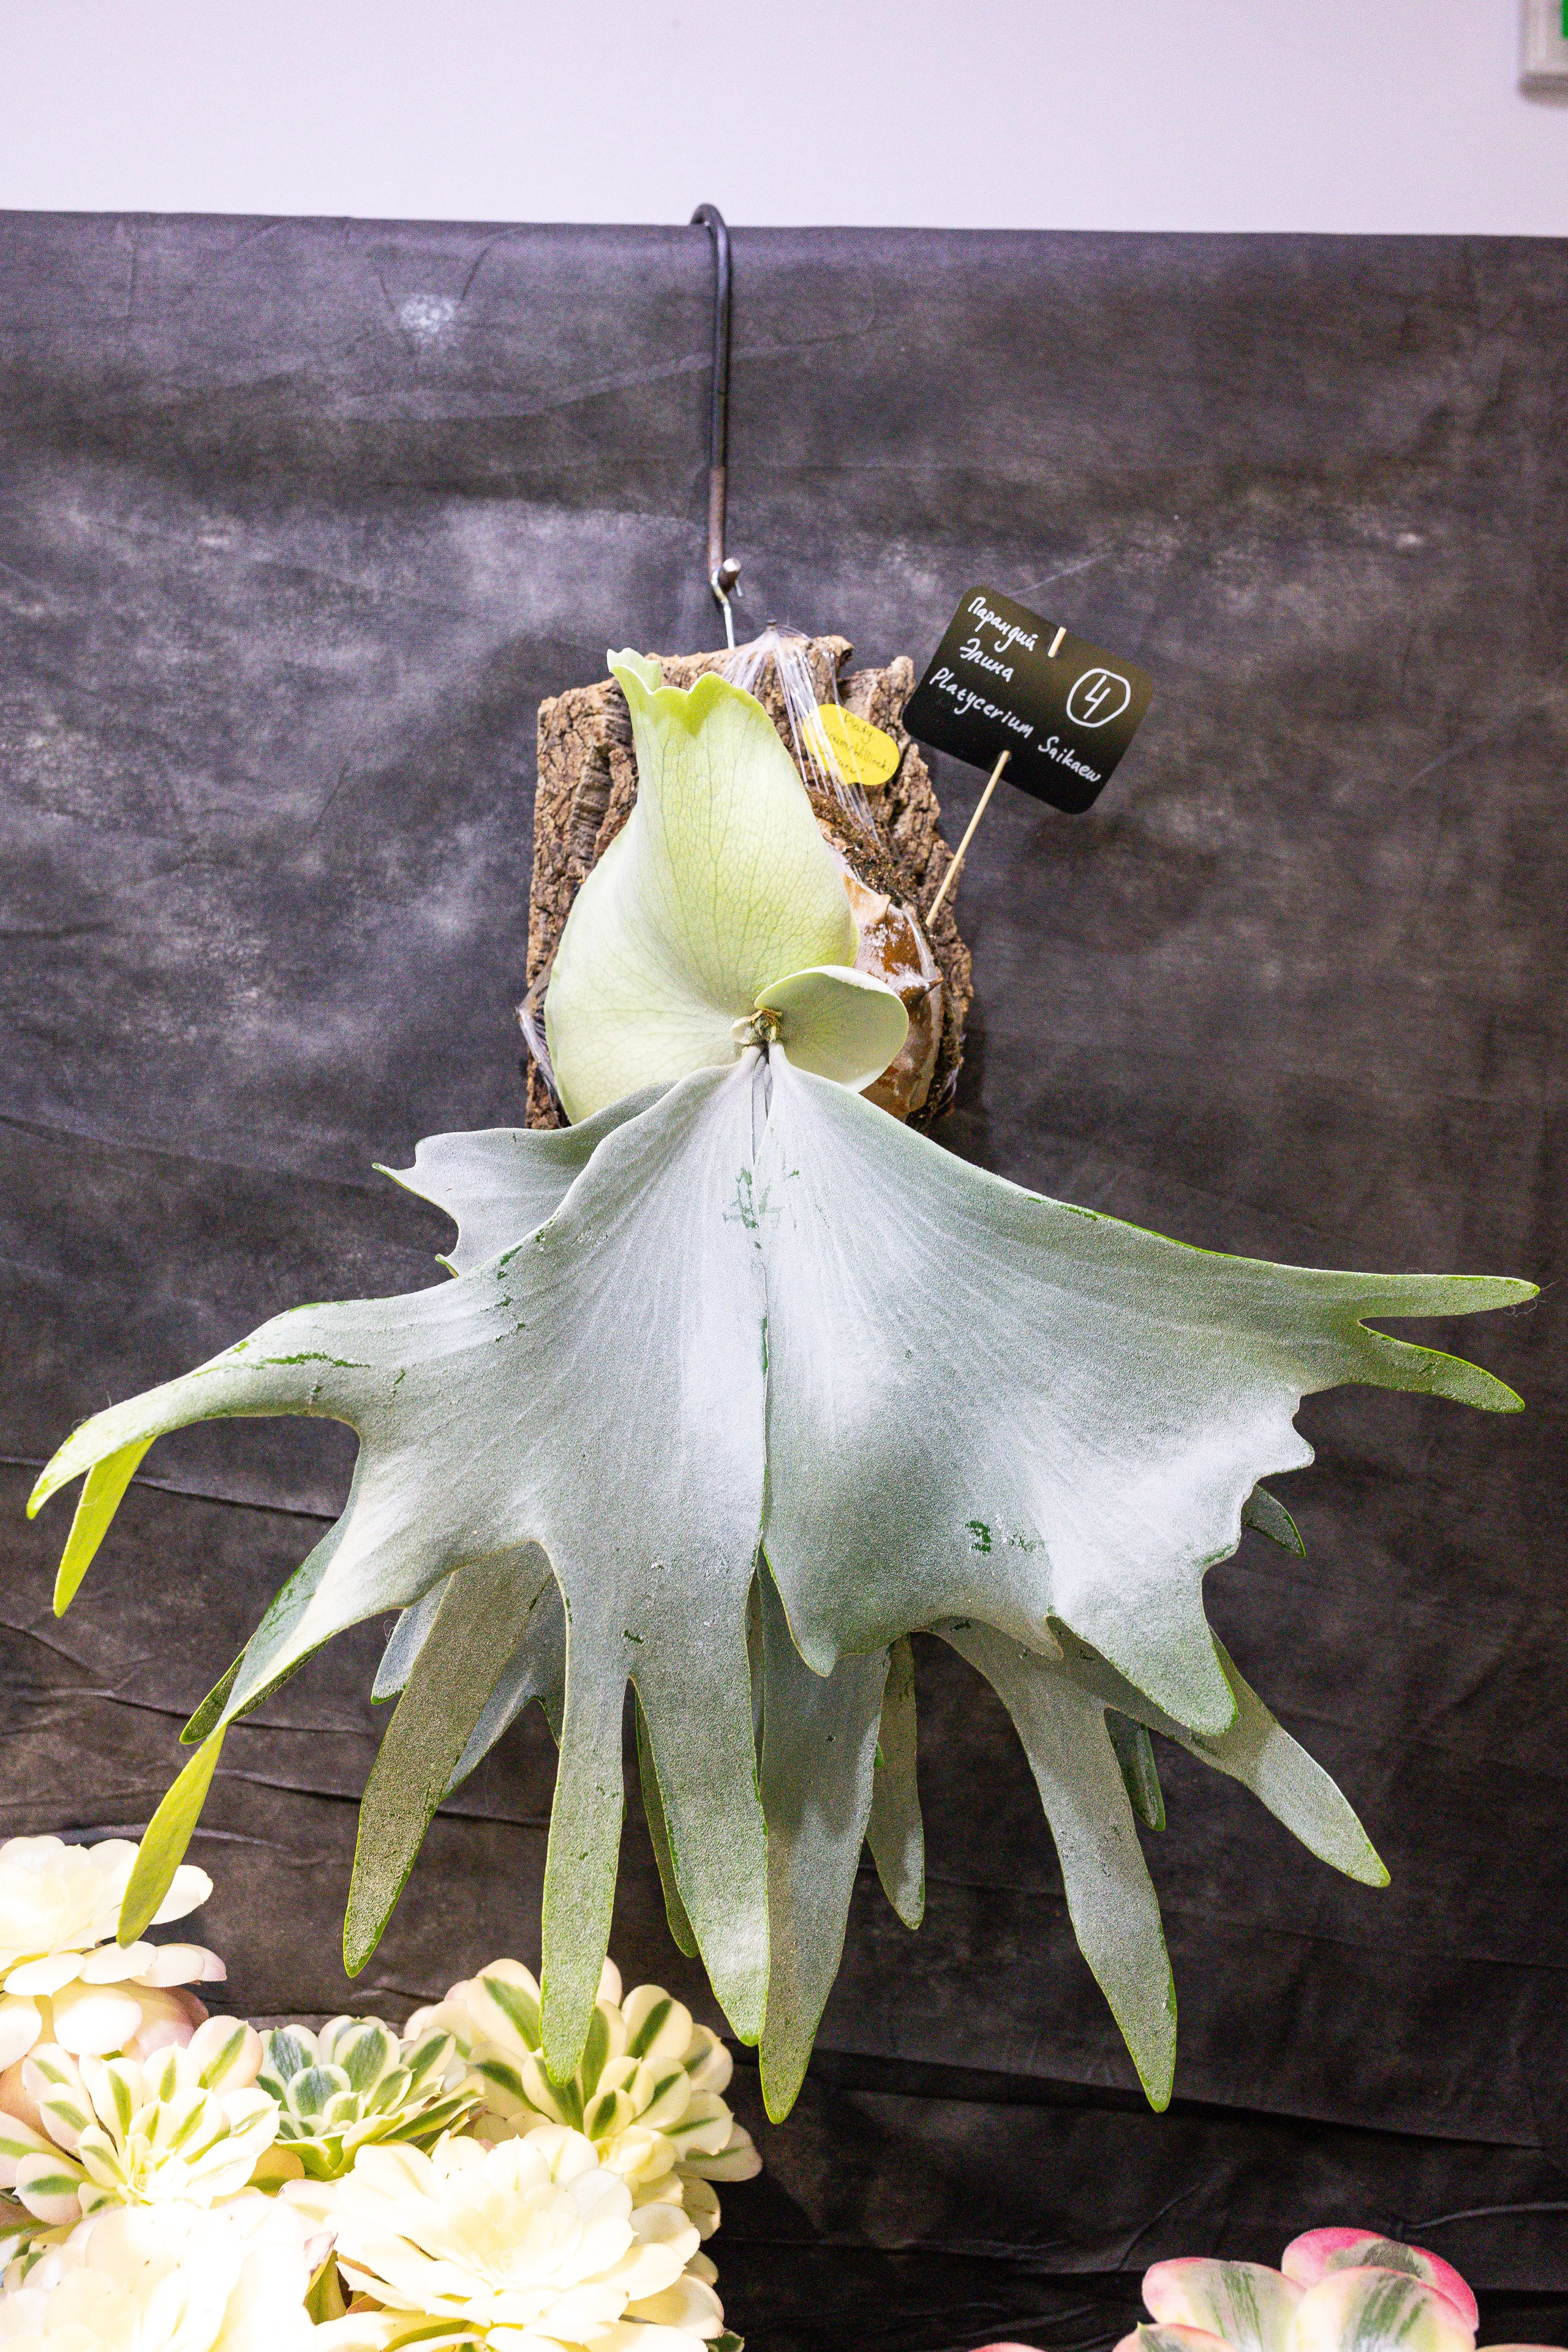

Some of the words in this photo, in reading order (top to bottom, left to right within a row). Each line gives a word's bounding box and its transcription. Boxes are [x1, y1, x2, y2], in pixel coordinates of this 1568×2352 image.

[959, 638, 1014, 682] Элина
[1084, 674, 1111, 721] 4
[929, 667, 1034, 738] Platycerium
[1038, 736, 1101, 782] Saikaew
